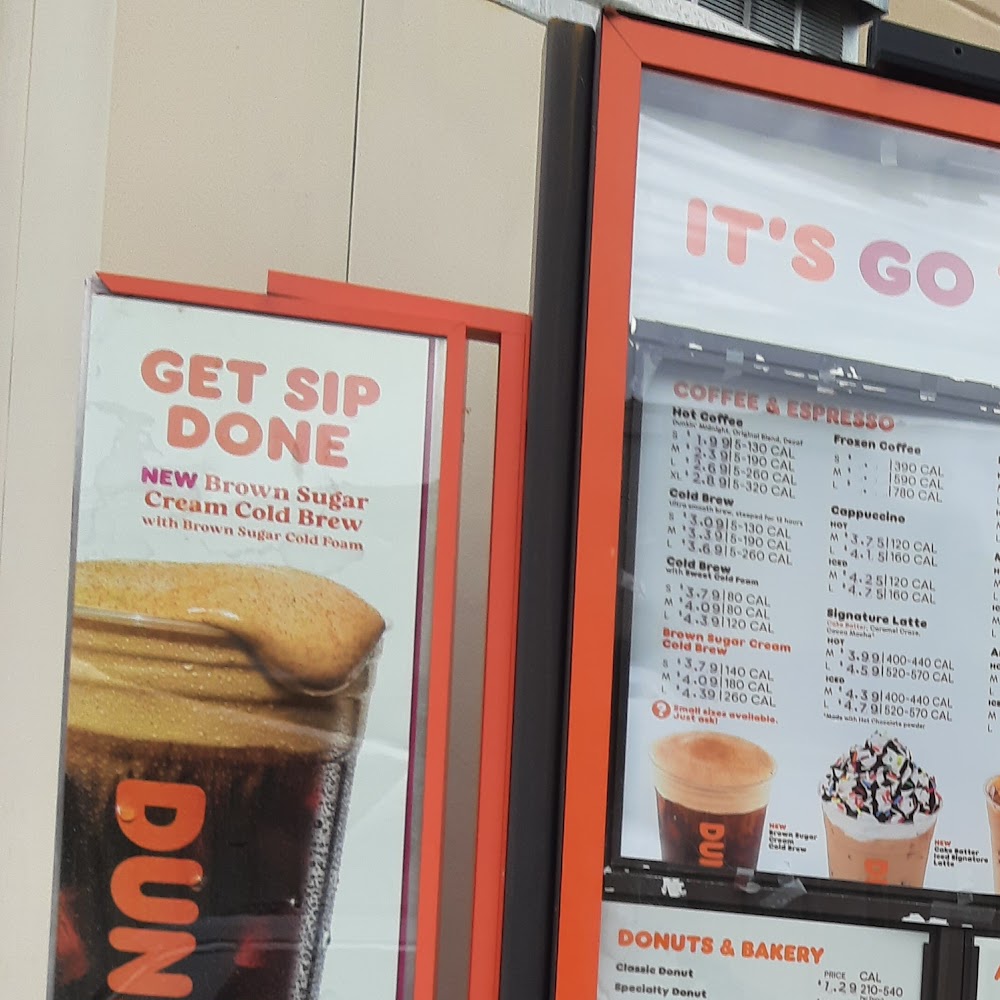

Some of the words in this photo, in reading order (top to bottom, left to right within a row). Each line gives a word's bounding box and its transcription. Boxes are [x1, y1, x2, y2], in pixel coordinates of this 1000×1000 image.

[685, 197, 836, 282] IT'S
[859, 239, 975, 307] GO
[141, 348, 267, 404] GET
[284, 367, 381, 418] SIP
[672, 406, 696, 420] Hot
[700, 411, 744, 427] Coffee
[673, 381, 759, 411] COFFEE
[766, 396, 780, 415] &
[787, 402, 895, 432] ESPRESSO
[167, 404, 351, 468] DONE
[833, 434, 876, 449] Frozen
[879, 441, 921, 455] Coffee
[141, 466, 198, 489] NEW
[204, 474, 289, 502] Brown
[296, 487, 369, 511] Sugar
[669, 488, 698, 501] Cold
[701, 493, 734, 507] Brew
[144, 491, 228, 518] Cream
[234, 501, 290, 525] Cold
[298, 509, 363, 532] Brew
[831, 505, 906, 525] Cappuccino
[141, 515, 179, 530] with
[182, 520, 234, 537] Brown
[238, 525, 282, 543] Sugar
[285, 530, 319, 546] Cold
[322, 536, 364, 551] Foam
[827, 607, 888, 627] Signature
[892, 616, 927, 628] Latte
[662, 628, 703, 642] Brown
[707, 633, 746, 647] Sugar
[749, 638, 791, 653] Cream
[618, 928, 714, 954] DONUTS
[719, 939, 735, 957] &
[741, 941, 824, 965] BAKERY
[615, 963, 656, 975] Classic
[659, 966, 694, 979] Donut
[614, 983, 670, 998] Specialty
[672, 988, 707, 999] Donut
